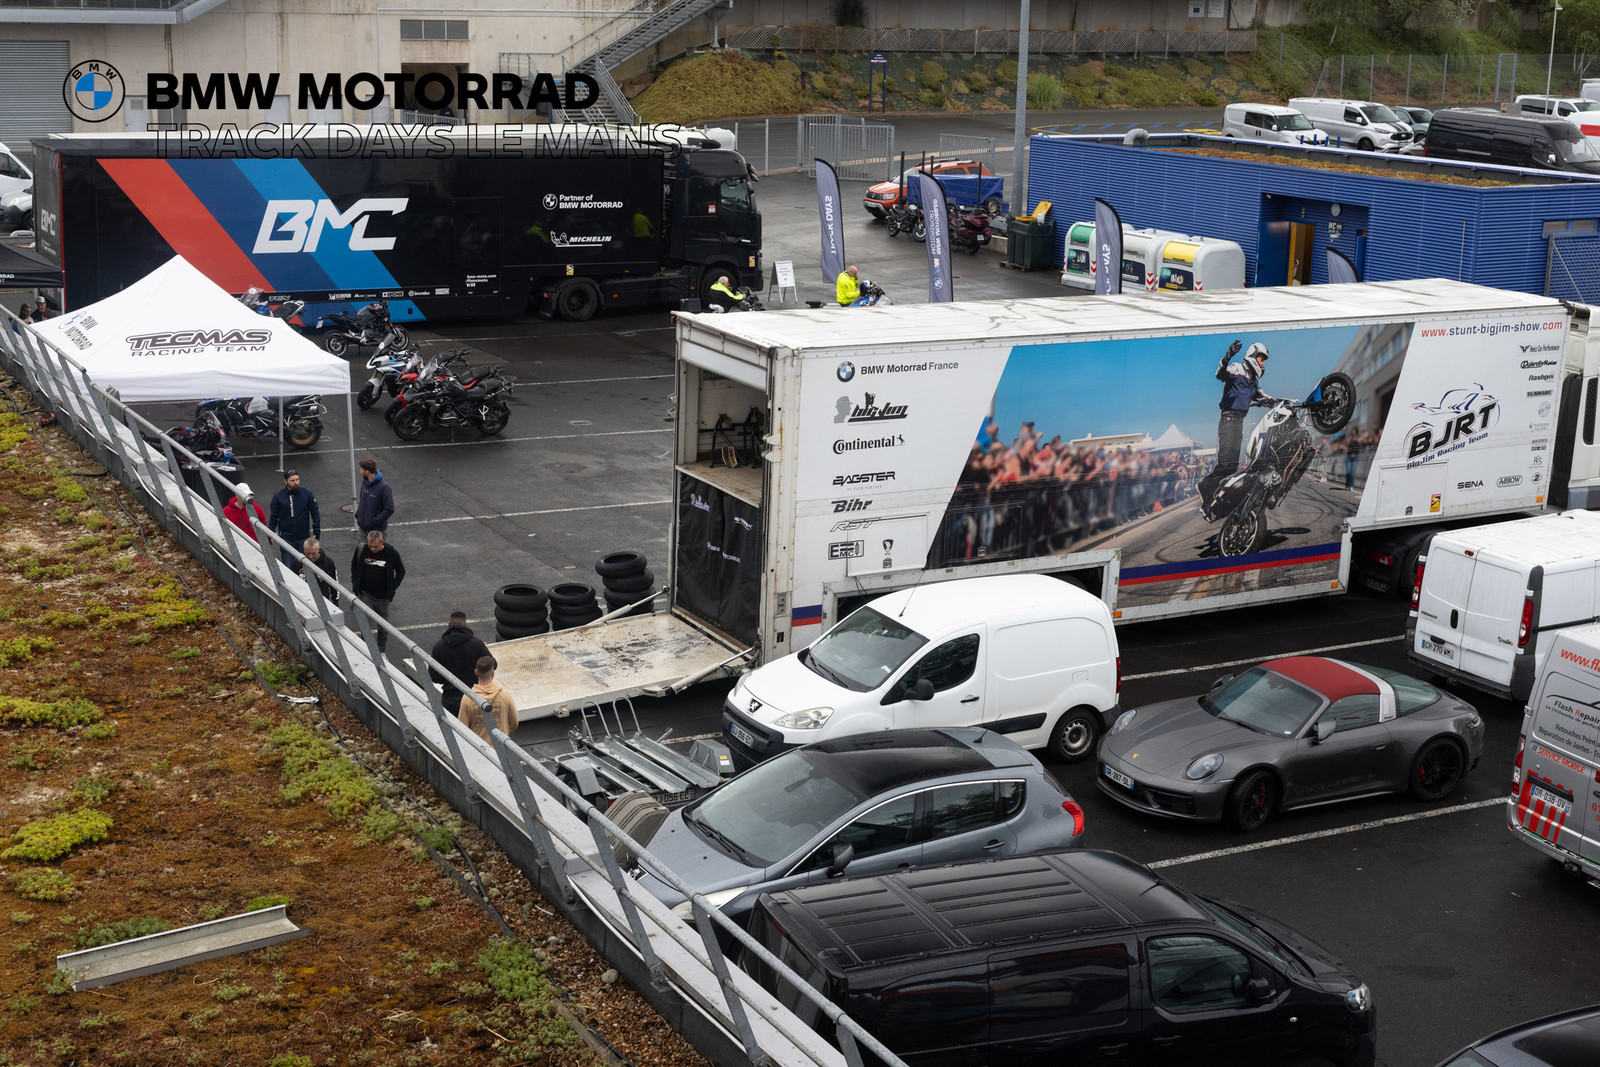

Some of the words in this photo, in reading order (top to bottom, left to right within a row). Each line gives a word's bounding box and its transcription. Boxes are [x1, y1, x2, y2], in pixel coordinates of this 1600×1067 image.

[252, 198, 409, 254] BMC
[1421, 321, 1562, 338] www.stunt-bigjim-show.com
[126, 329, 272, 351] TECMAS
[131, 348, 204, 357] RACING
[861, 366, 884, 375] BMW
[887, 362, 927, 373] Motorrad
[928, 362, 958, 370] France
[1408, 402, 1497, 459] BJRT
[832, 436, 895, 454] Continental
[1438, 440, 1466, 457] Racing
[1468, 432, 1488, 444] Team
[832, 471, 896, 486] BAGSTER
[1457, 480, 1484, 490] SENA
[1498, 476, 1520, 485] ARROW
[831, 498, 873, 513] Bihr
[830, 516, 881, 532] RST
[1554, 700, 1574, 713] Flash
[1555, 724, 1582, 740] Retouches
[1572, 742, 1590, 754] Jantes
[1538, 747, 1561, 762] SERVICE
[1561, 758, 1585, 774] MOBILE
